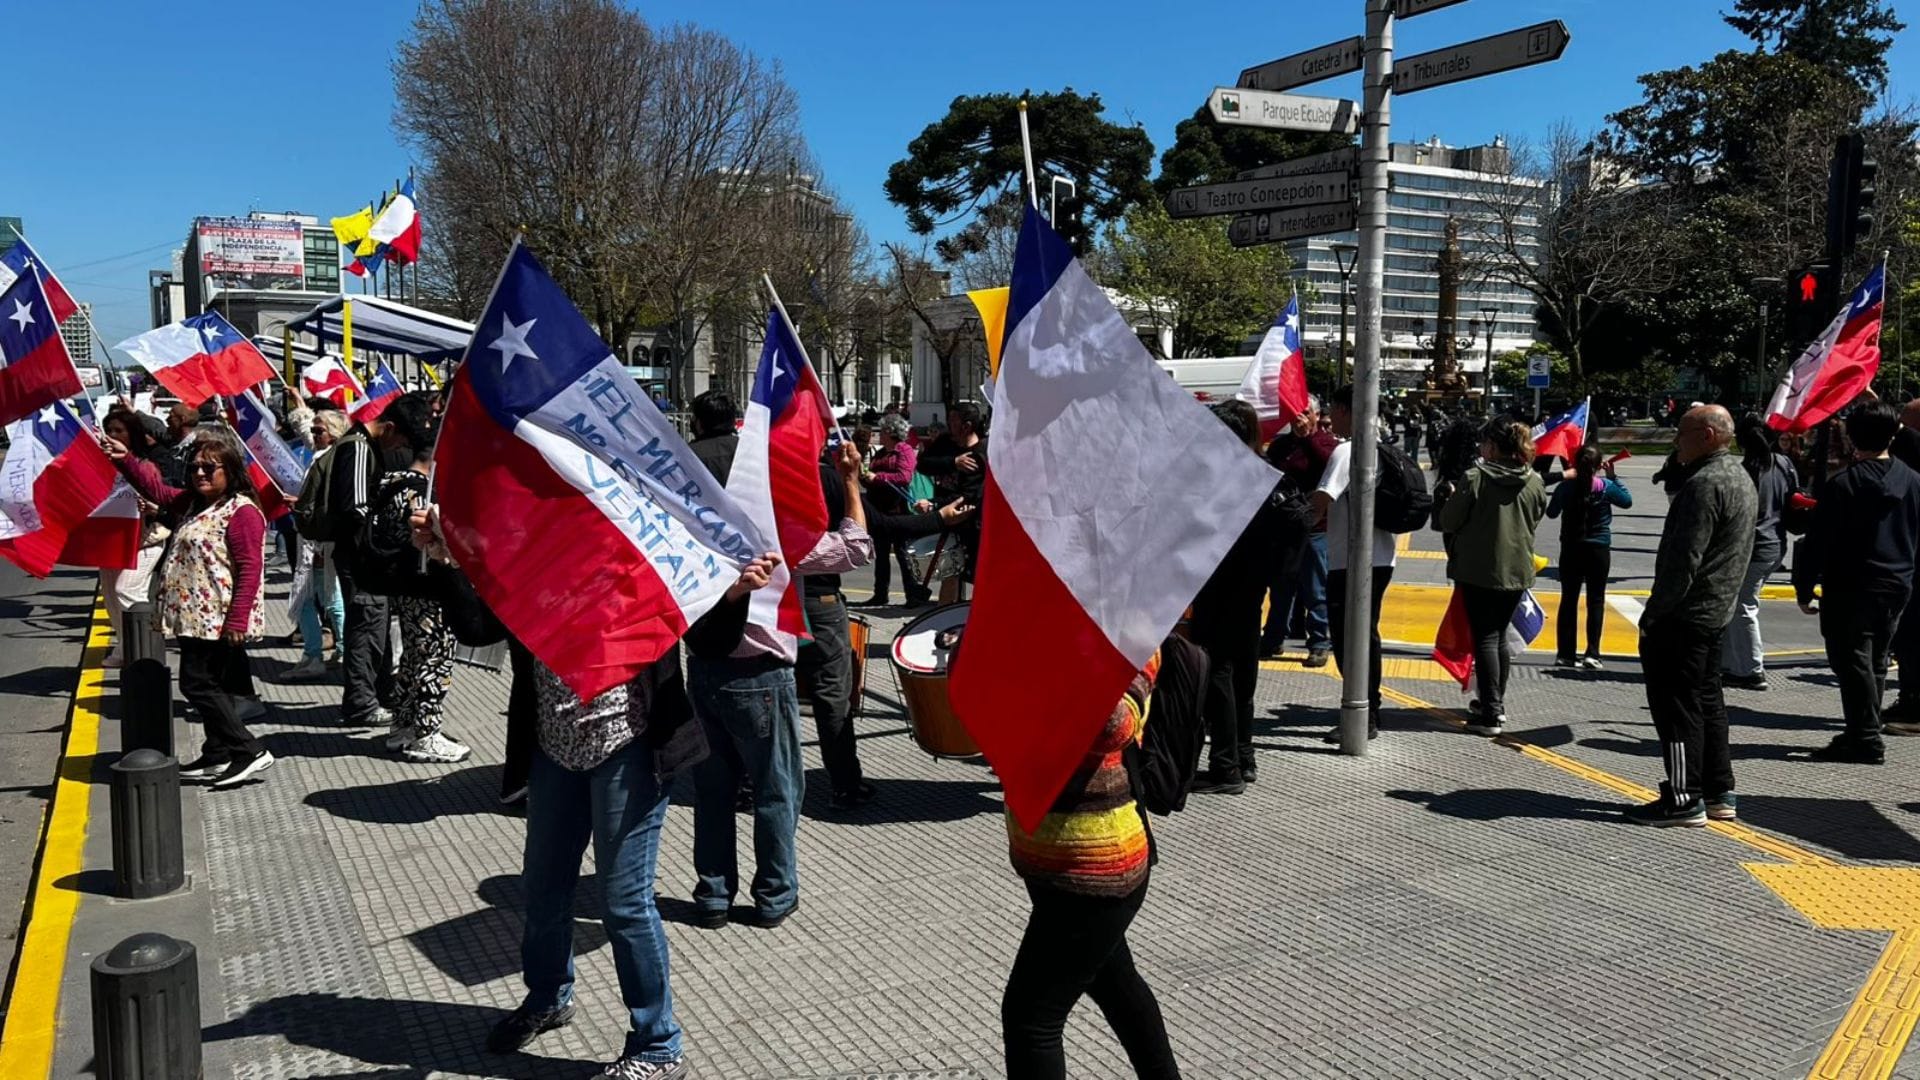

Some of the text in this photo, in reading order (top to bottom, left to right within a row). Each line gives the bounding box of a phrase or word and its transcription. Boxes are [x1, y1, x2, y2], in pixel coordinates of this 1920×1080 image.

[1301, 48, 1342, 76] Catedral
[1414, 54, 1471, 81] Tribunales
[1262, 101, 1299, 124] Parque
[1207, 180, 1324, 208] Teatro Concepción
[1280, 210, 1336, 232] Intendencia
[564, 412, 607, 447] NO
[7, 457, 36, 529] MERCADO
[637, 436, 753, 563] MERCADO
